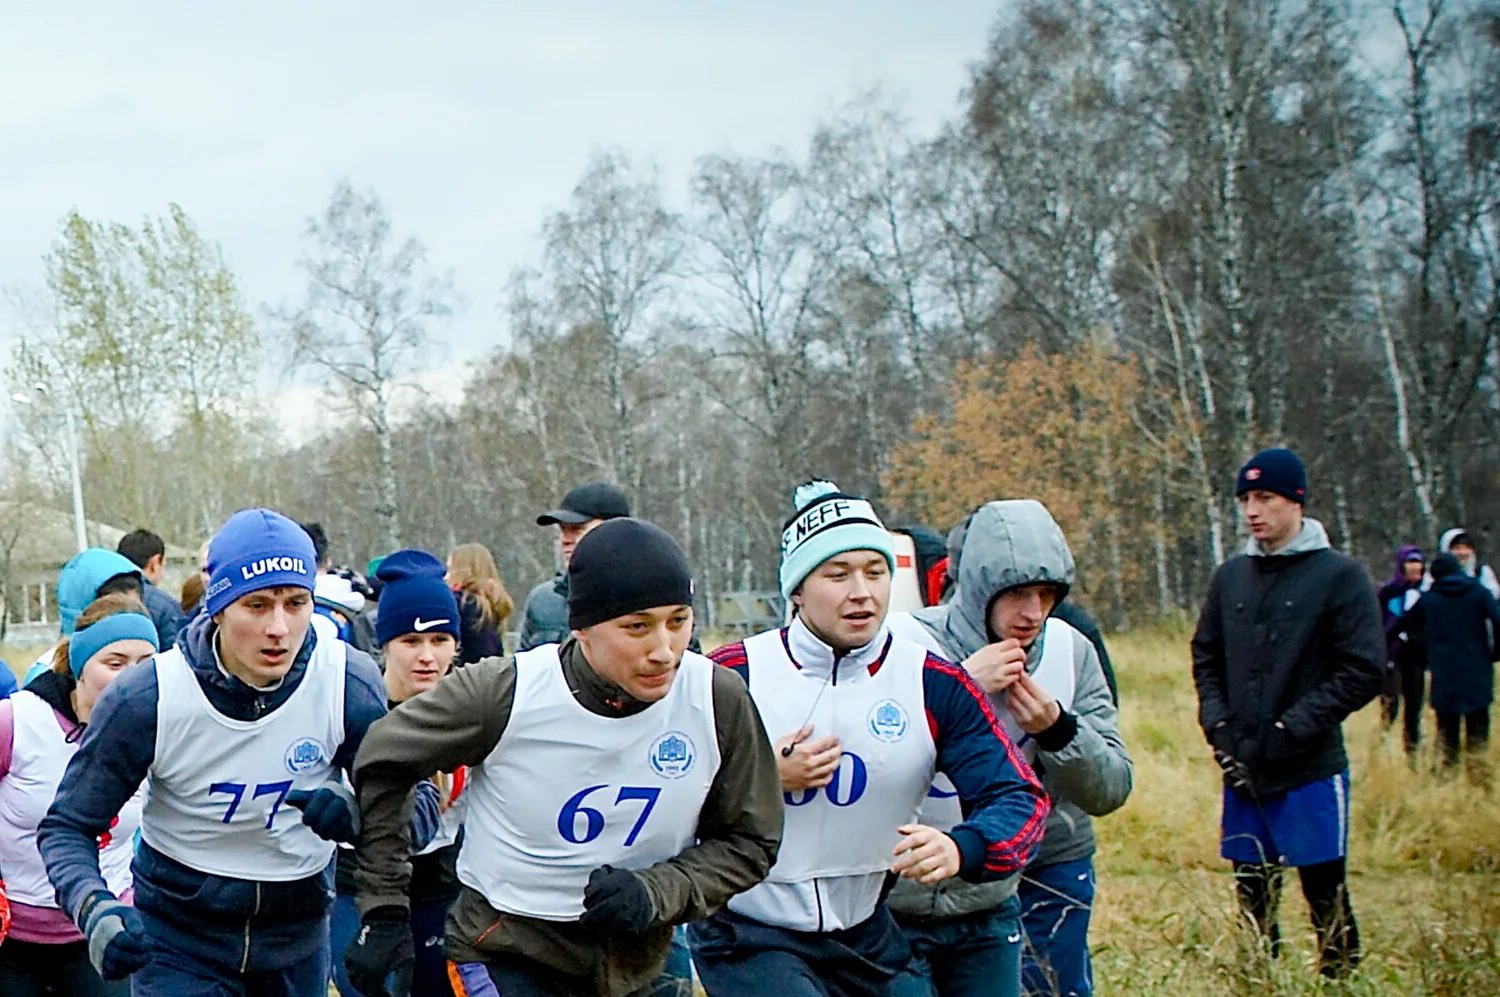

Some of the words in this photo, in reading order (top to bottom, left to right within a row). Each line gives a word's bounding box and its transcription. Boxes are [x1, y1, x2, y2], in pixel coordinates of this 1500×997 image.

[796, 501, 850, 541] NEFF
[241, 557, 307, 580] LUKOIL
[208, 780, 294, 830] 77
[557, 784, 662, 847] 67
